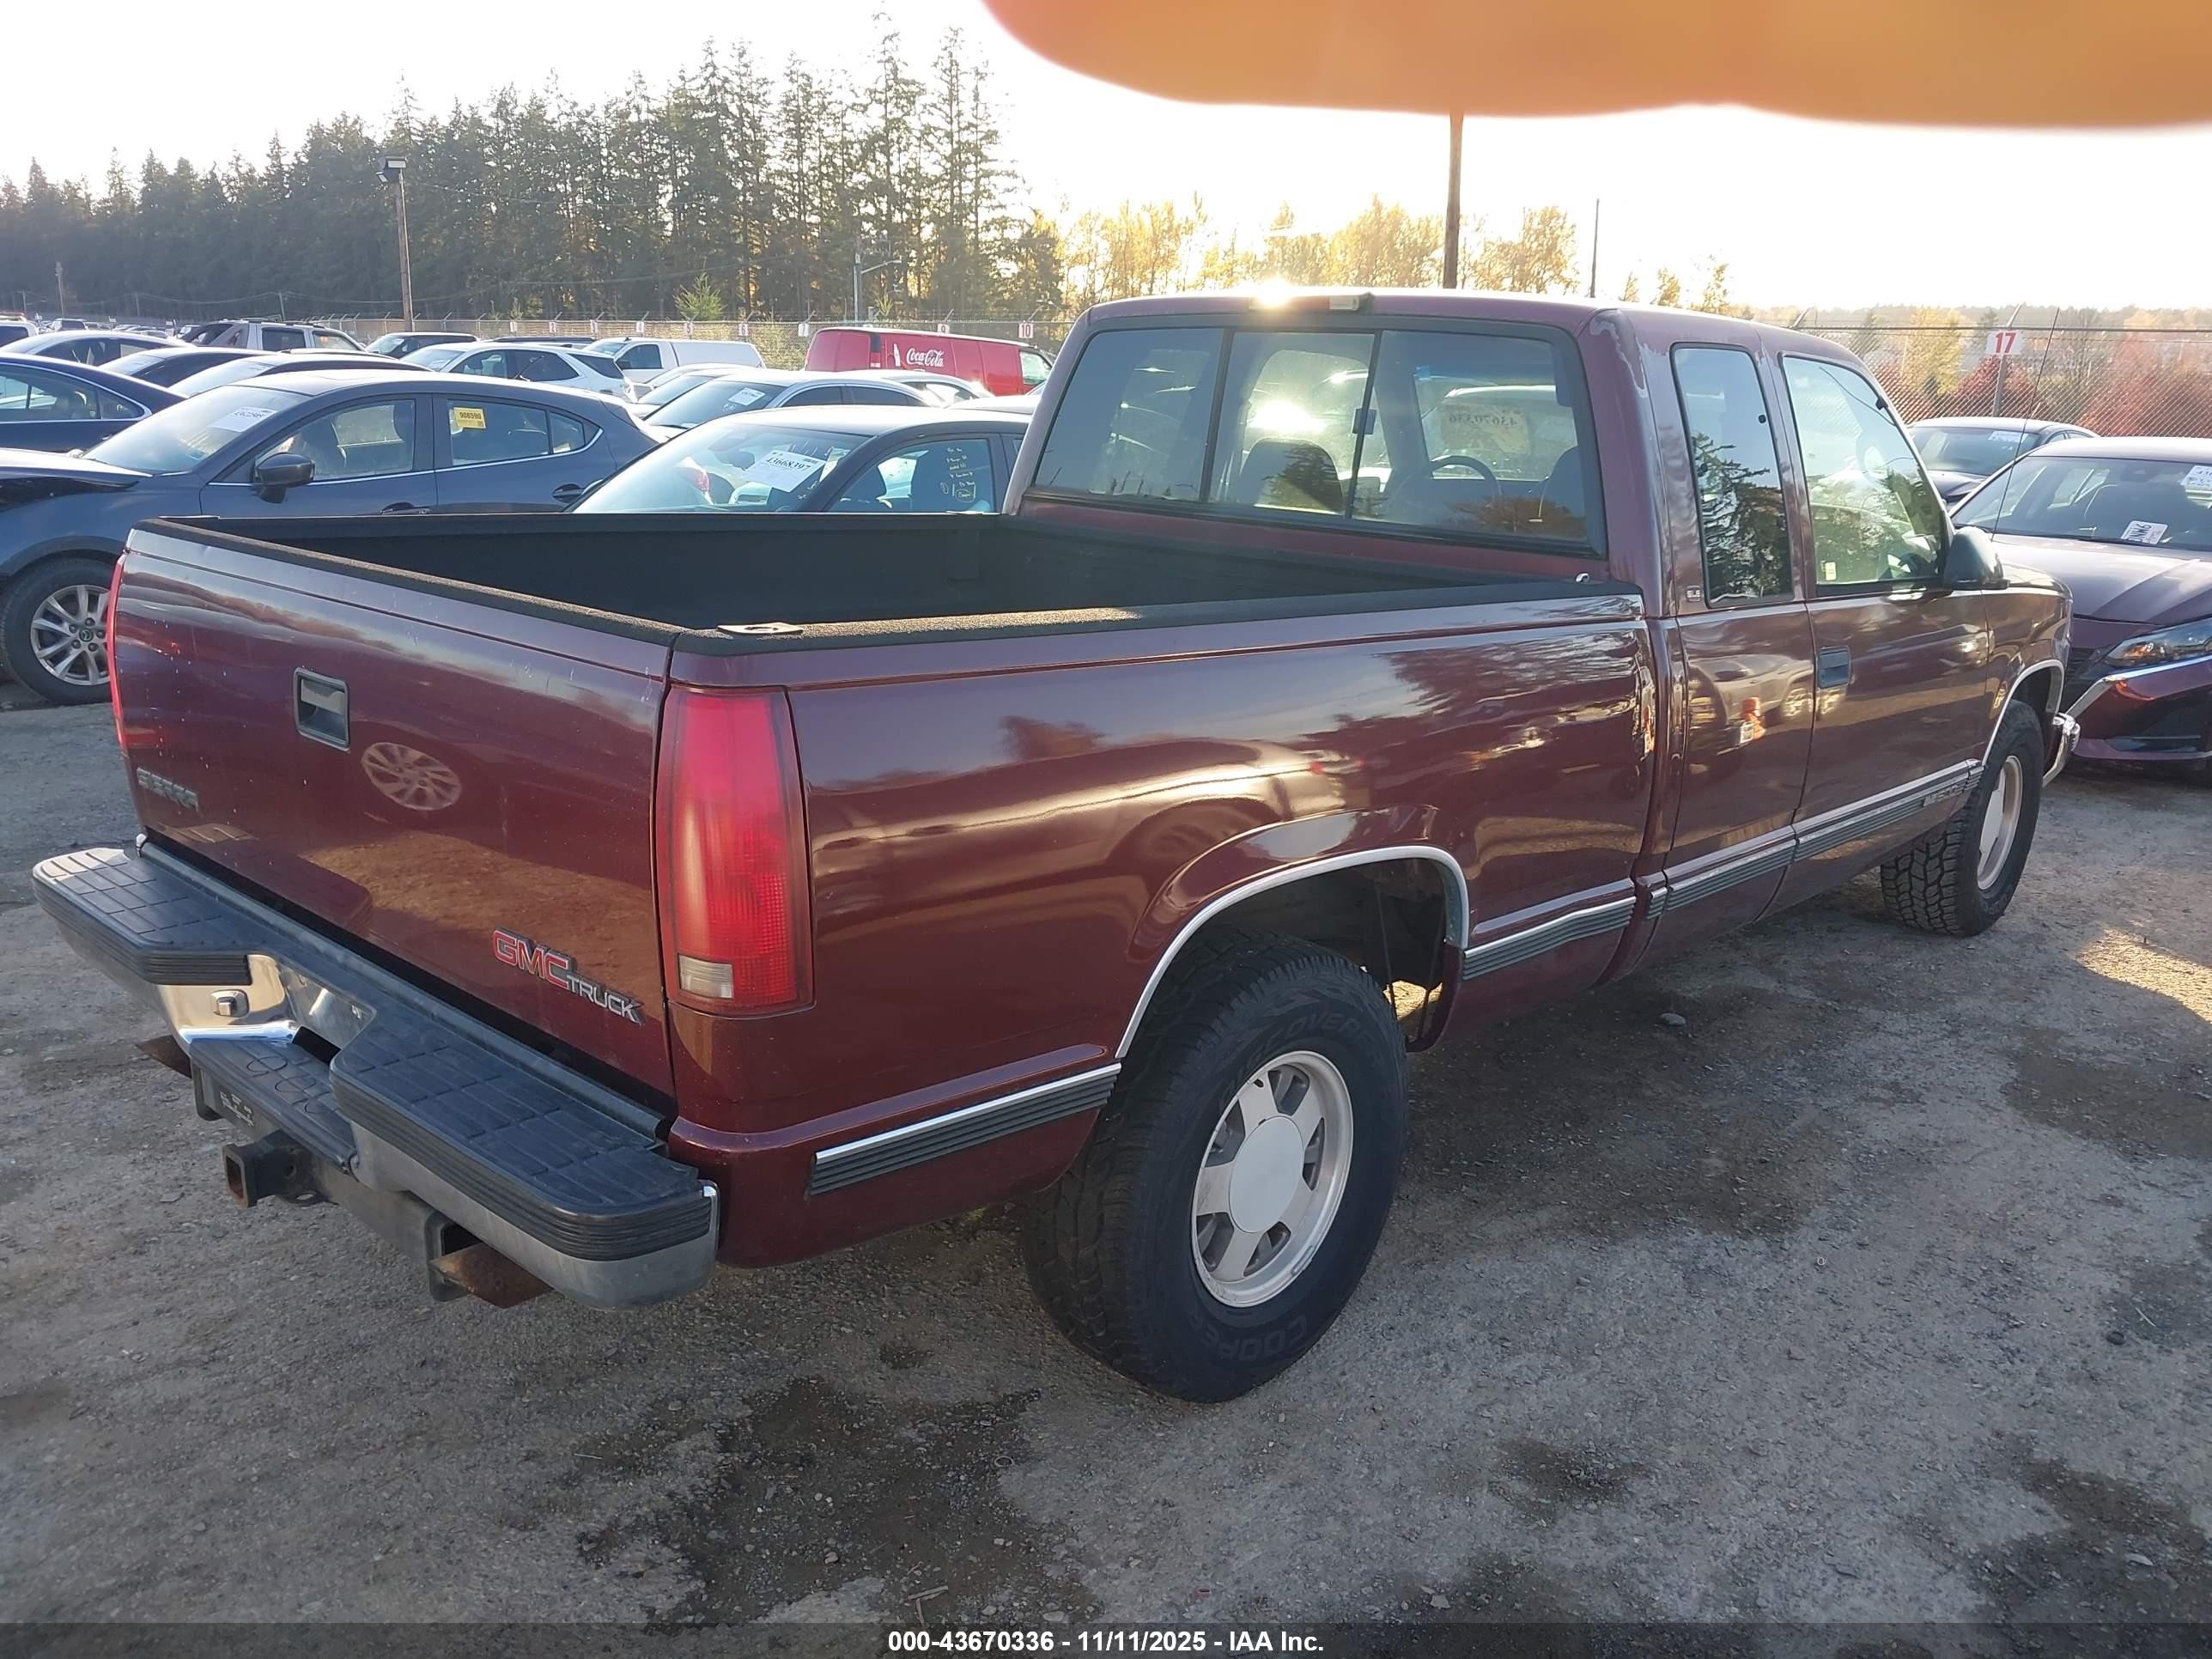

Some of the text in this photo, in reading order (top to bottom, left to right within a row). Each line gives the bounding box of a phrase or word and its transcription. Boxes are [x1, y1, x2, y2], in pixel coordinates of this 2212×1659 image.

[1022, 325, 1031, 337] 10
[1996, 332, 2016, 353] 17
[906, 348, 945, 367] Coca-Cola
[137, 767, 199, 811] SIERRA
[493, 929, 643, 1025] GMC TRUCK
[1185, 1304, 1310, 1364] COOPER
